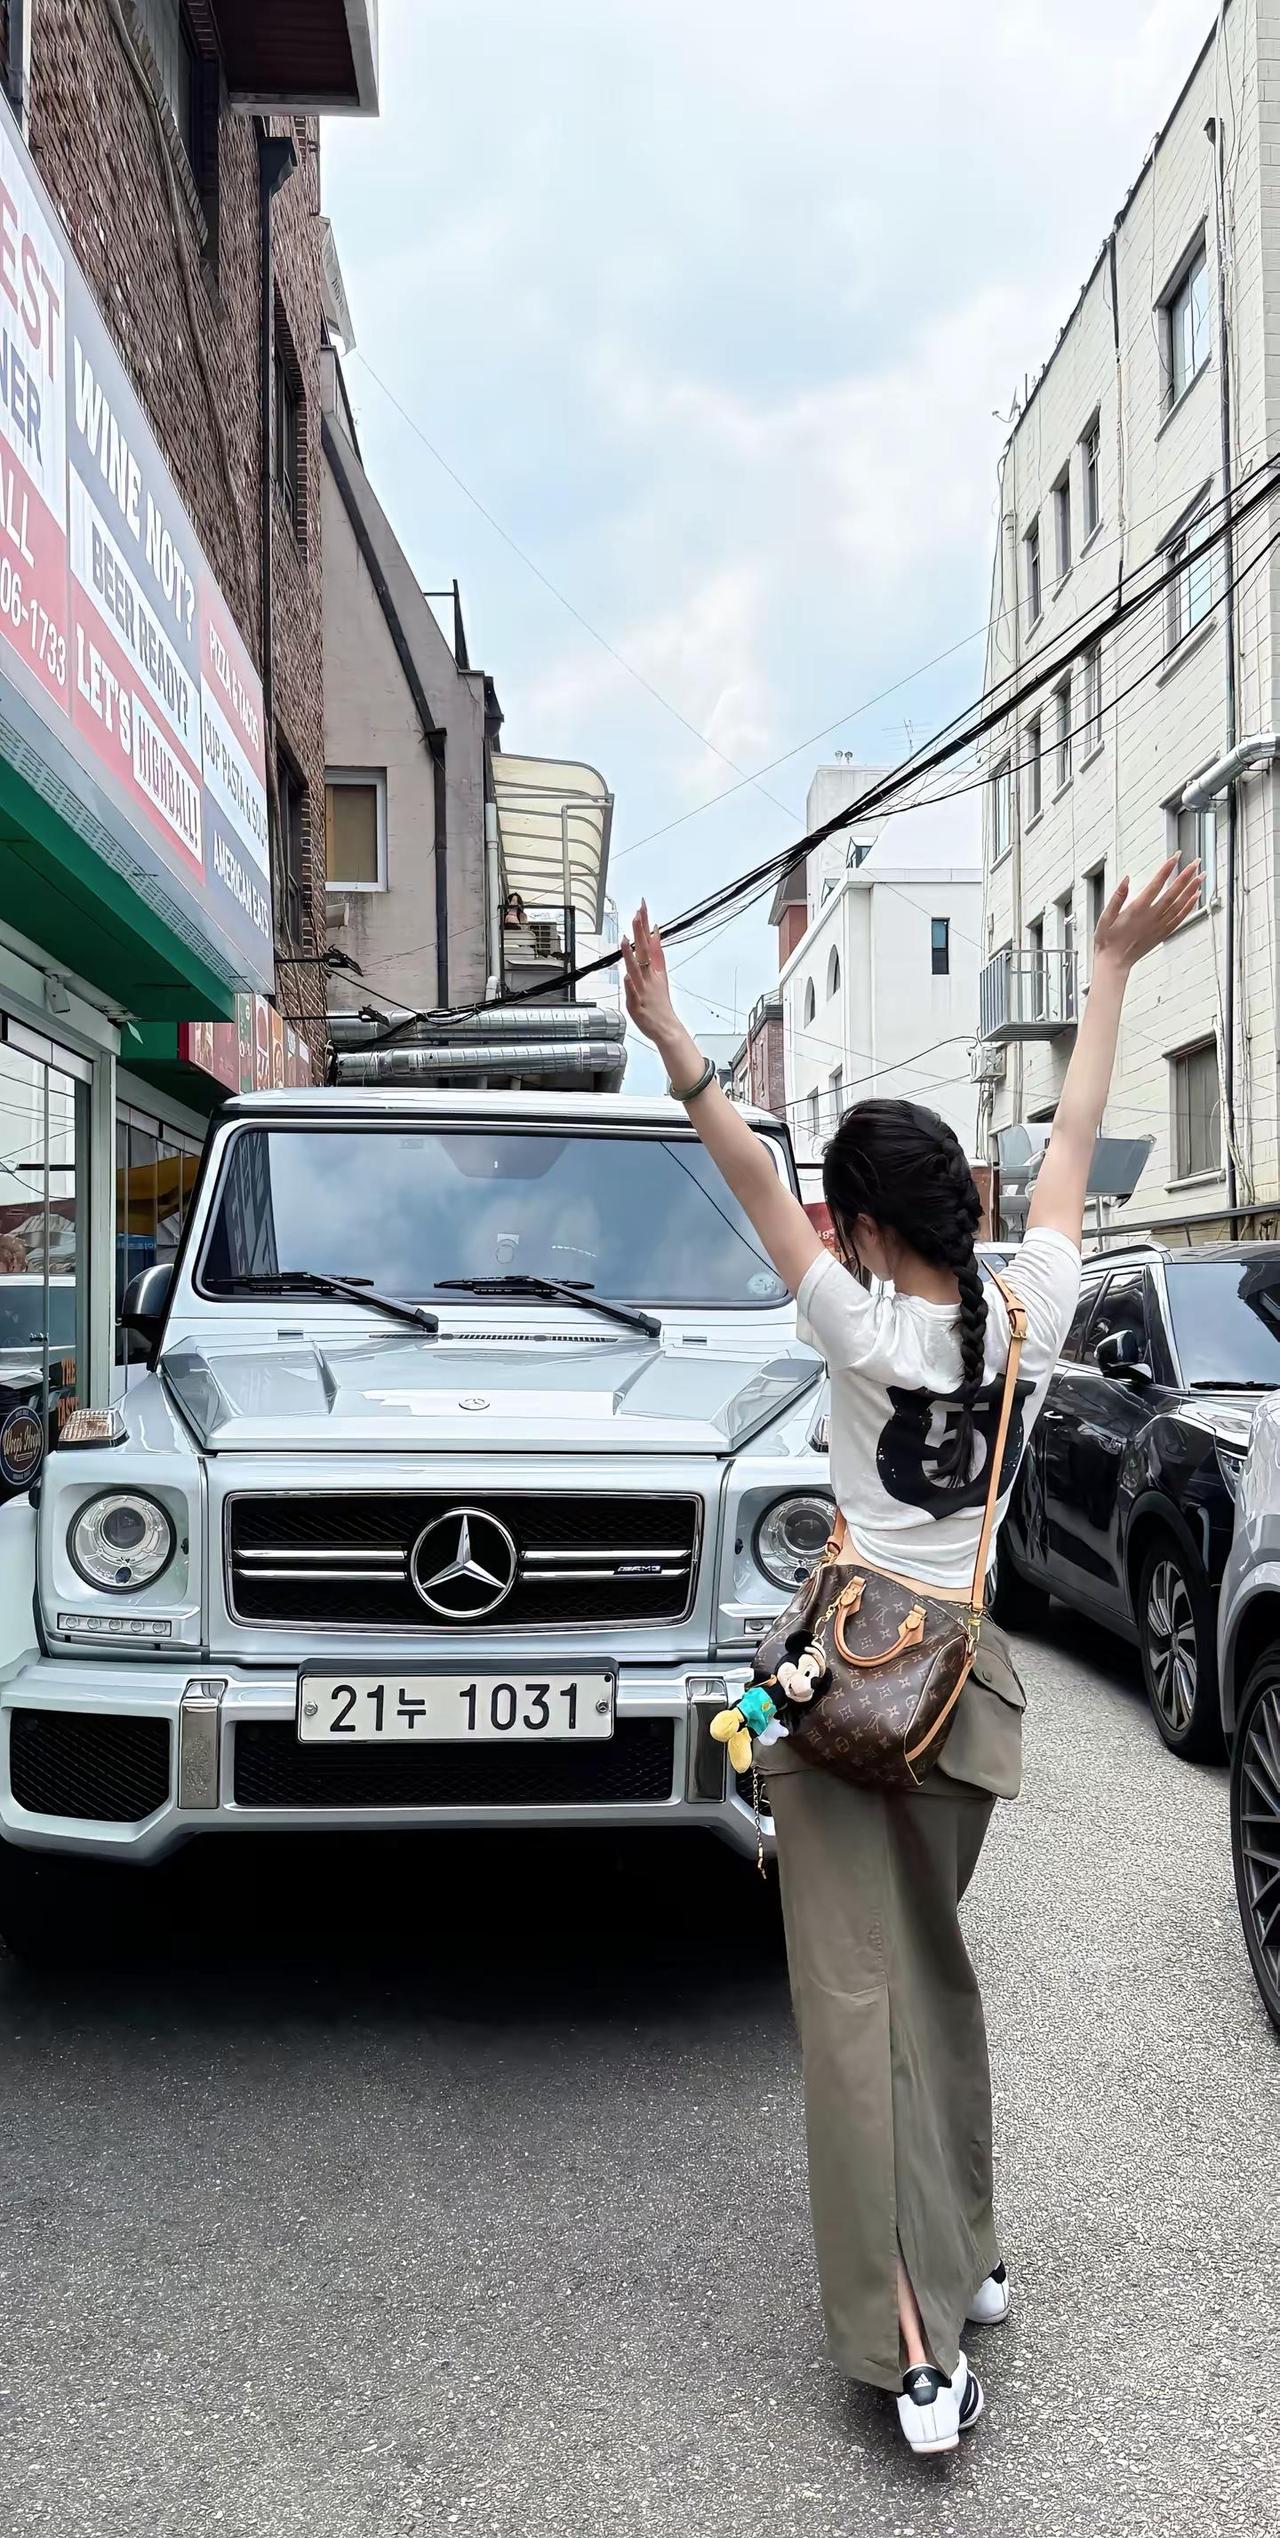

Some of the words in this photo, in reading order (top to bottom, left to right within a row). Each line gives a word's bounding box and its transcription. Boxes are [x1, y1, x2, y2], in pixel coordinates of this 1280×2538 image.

[0, 468, 35, 568] LL
[73, 336, 142, 543] WINE
[145, 490, 195, 642] NOT?
[91, 521, 136, 649] BEER
[138, 603, 189, 737] READY?
[209, 620, 232, 700] PIZZA
[76, 622, 132, 757] LET'S
[138, 714, 199, 849] HIGHBALL!
[203, 712, 220, 771] CUP
[222, 742, 246, 817] PASTA
[213, 829, 253, 920] AMERICAN
[252, 884, 269, 940] EATS
[61, 1359, 76, 1386] THE
[921, 1400, 988, 1488] 5
[329, 1683, 427, 1733] 21누
[459, 1683, 578, 1731] 1031
